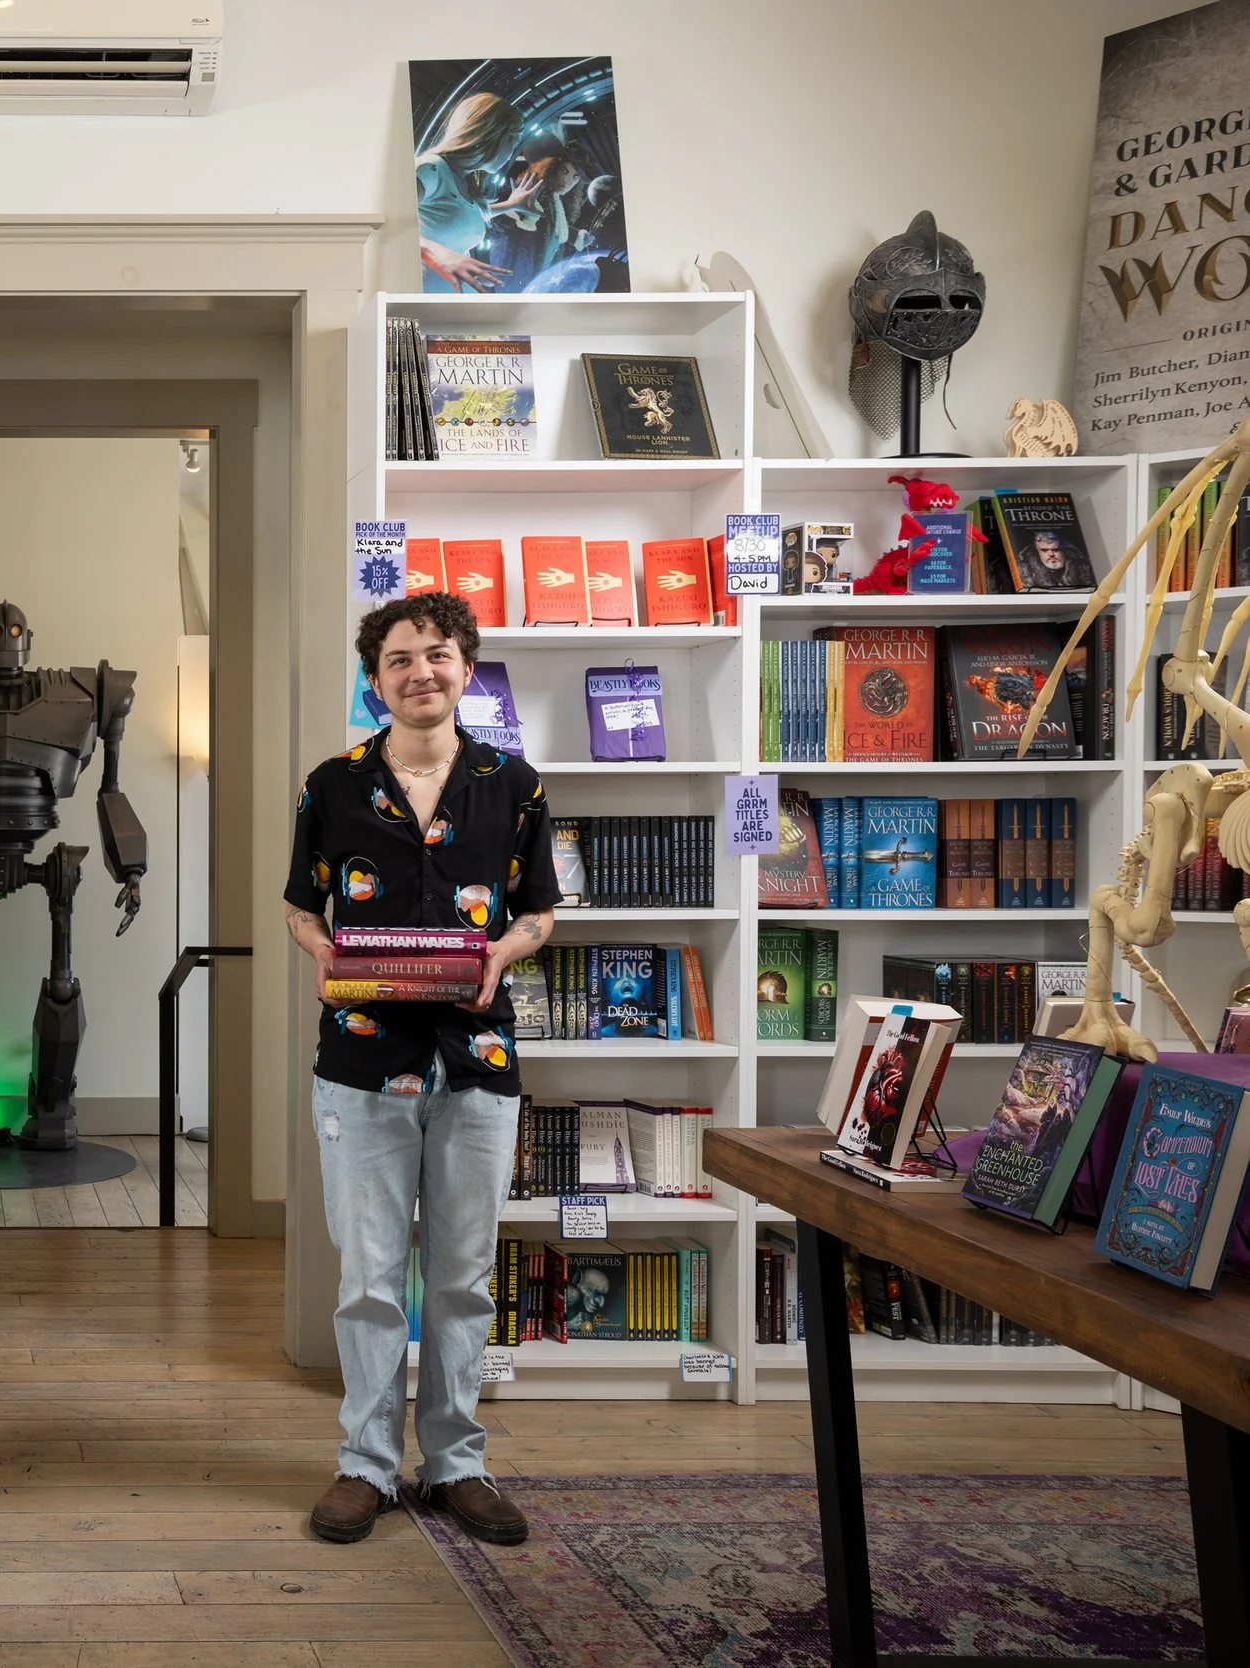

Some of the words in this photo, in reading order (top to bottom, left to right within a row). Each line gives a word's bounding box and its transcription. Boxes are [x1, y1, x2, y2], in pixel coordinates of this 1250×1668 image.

[1116, 106, 1250, 162] GEORG
[1114, 173, 1138, 197] &
[1106, 186, 1250, 250] DAN
[444, 345, 469, 354] GAME
[484, 345, 520, 354] THRONES
[435, 356, 491, 368] GEORGE
[617, 363, 658, 375] GAME
[1093, 372, 1122, 388] Jim
[1129, 358, 1199, 379] Butcher,
[437, 369, 524, 385] MARTIN
[614, 374, 675, 386] THRONES
[1092, 386, 1171, 408] Sherrilyn
[1174, 376, 1248, 395] Kenyon,
[1091, 418, 1122, 432] Kay
[1127, 407, 1200, 426] Penman,
[1204, 401, 1232, 418] Joe
[447, 428, 467, 437] THE
[470, 428, 504, 437] LANDS
[508, 428, 523, 437] OF
[440, 439, 467, 452] ICE
[471, 442, 494, 451] AND
[496, 439, 530, 452] FIRE
[728, 516, 753, 526] BOOK
[755, 515, 779, 525] CLUB
[1005, 508, 1075, 522] THRONE
[355, 522, 381, 532] BOOK
[382, 522, 406, 532] CLUB
[357, 538, 381, 546] Klara
[385, 538, 403, 547] and
[355, 546, 372, 555] the
[374, 546, 392, 555] Sun
[371, 564, 389, 577] 15%
[728, 563, 762, 573] HOSTED
[766, 563, 778, 572] BY
[371, 577, 389, 589] OFF
[728, 574, 768, 590] David
[844, 629, 896, 641] GEORGE
[845, 642, 928, 660] MARTIN
[590, 679, 628, 693] BEASTLY
[1001, 713, 1023, 722] RISE
[869, 720, 905, 730] WORLD
[843, 730, 871, 750] ICE
[873, 733, 887, 747] &
[890, 730, 929, 750] FIRE
[742, 788, 761, 798] ALL
[737, 798, 768, 809] GRRM
[736, 810, 769, 820] TITLES
[868, 806, 915, 818] GEORGE
[742, 821, 763, 831] ARE
[867, 819, 936, 834] MARTIN
[556, 829, 579, 841] AND
[733, 831, 772, 842] SIGNED
[557, 841, 572, 850] DIE
[764, 869, 807, 879] MYSTERY
[877, 878, 922, 892] GAME
[868, 893, 934, 907] THRONES
[342, 935, 419, 948] LEVIATHAN
[418, 937, 465, 949] WAKES
[601, 949, 654, 961] STEPHEN
[372, 962, 443, 976] QUILLIFER
[601, 961, 654, 979] KING
[1041, 970, 1073, 979] GEORGE
[407, 984, 434, 993] KNIGHT
[1041, 979, 1087, 990] MARTIN
[331, 988, 374, 999] MARTIN
[607, 1005, 639, 1018] DEAD
[620, 1016, 649, 1027] ZONE
[1010, 1139, 1024, 1152] the
[982, 1145, 1044, 1172] ENCHANTED
[975, 1157, 1042, 1187] GREENHOUSE
[977, 1173, 995, 1185] SARAH
[994, 1178, 1008, 1188] BETH
[1008, 1182, 1027, 1195] DURST
[561, 1196, 586, 1205] STAFF
[587, 1196, 606, 1205] PICK
[508, 1242, 518, 1263] BRAM
[507, 1264, 518, 1302] STOKER'S
[507, 1310, 517, 1345] DRACULA
[597, 1331, 622, 1339] STROUD
